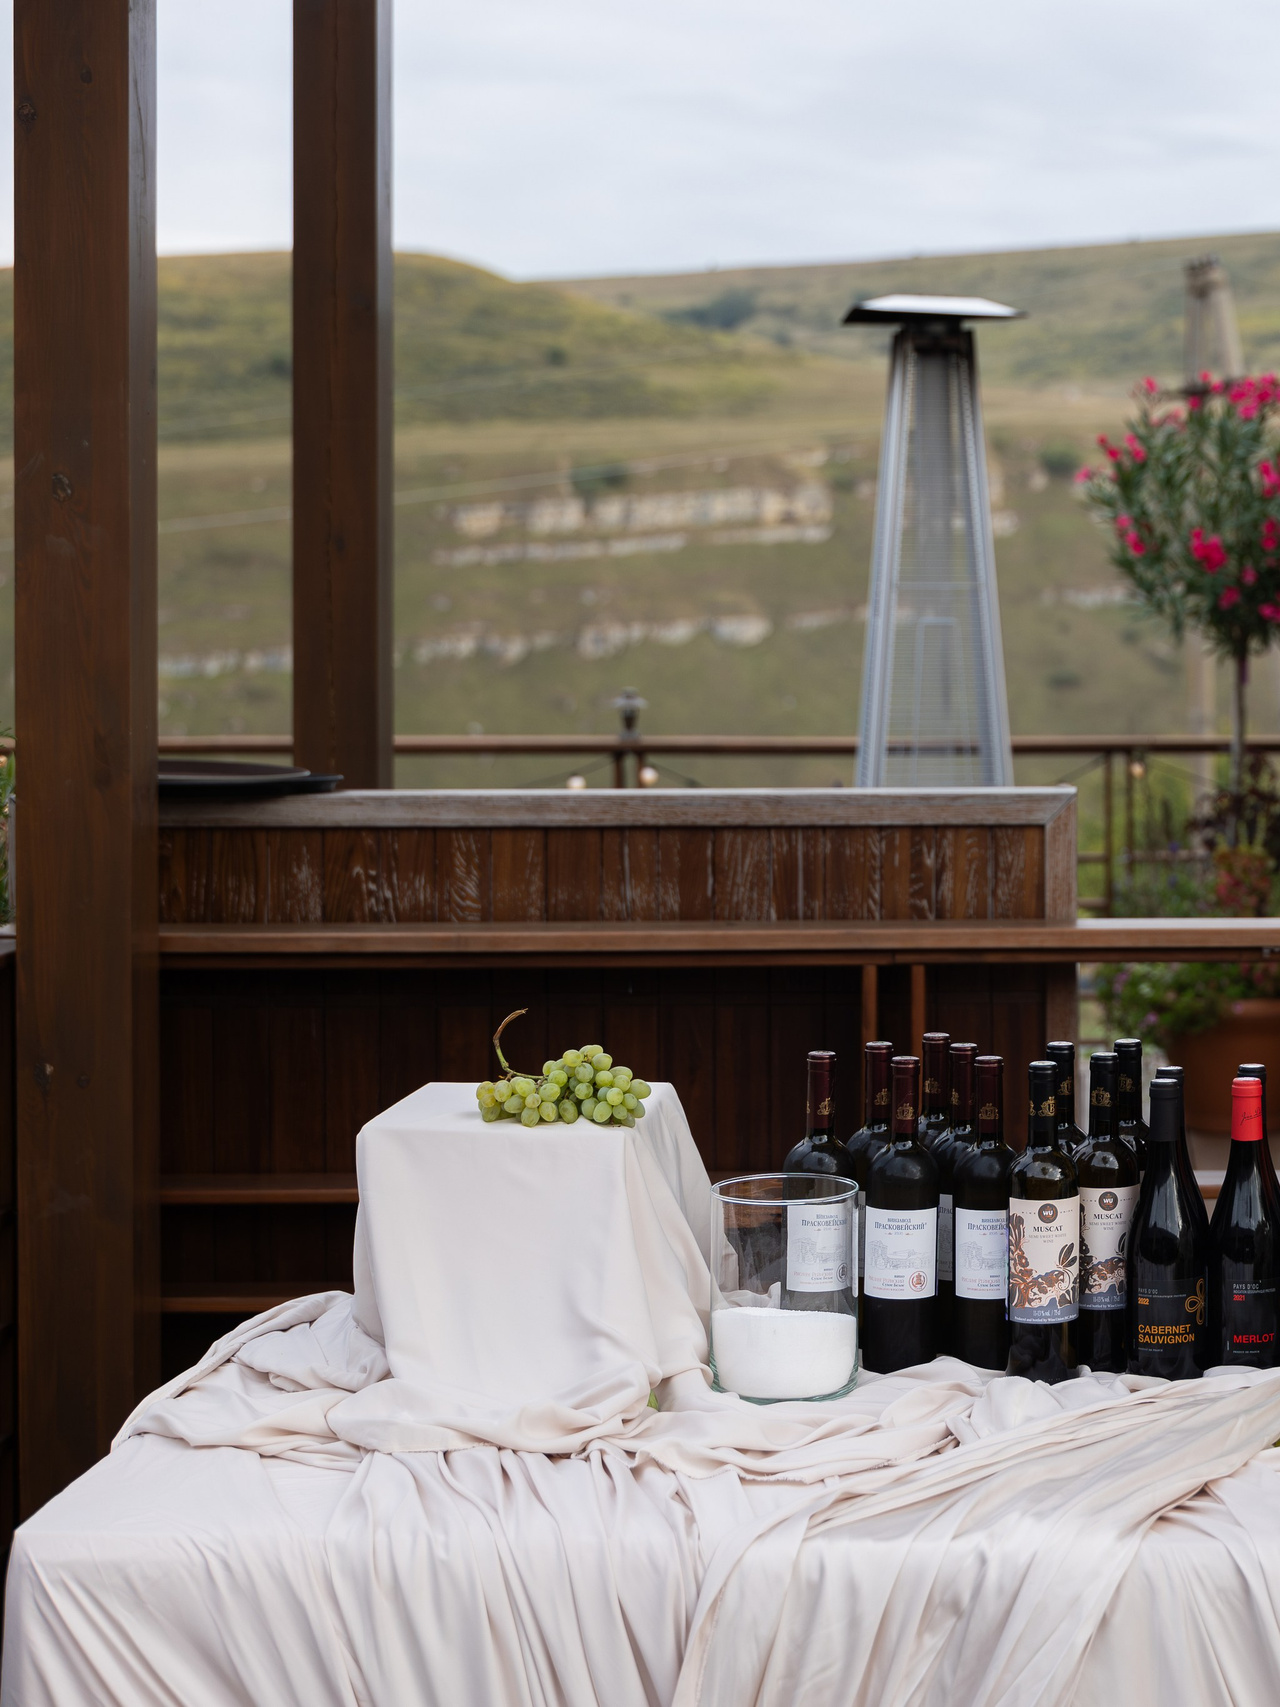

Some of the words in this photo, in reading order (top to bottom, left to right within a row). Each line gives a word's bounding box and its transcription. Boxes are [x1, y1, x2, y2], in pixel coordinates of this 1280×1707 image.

[1138, 1324, 1191, 1335] CABERNET
[1138, 1333, 1195, 1344] SAUVIGNON
[1233, 1332, 1275, 1344] MERLOT
